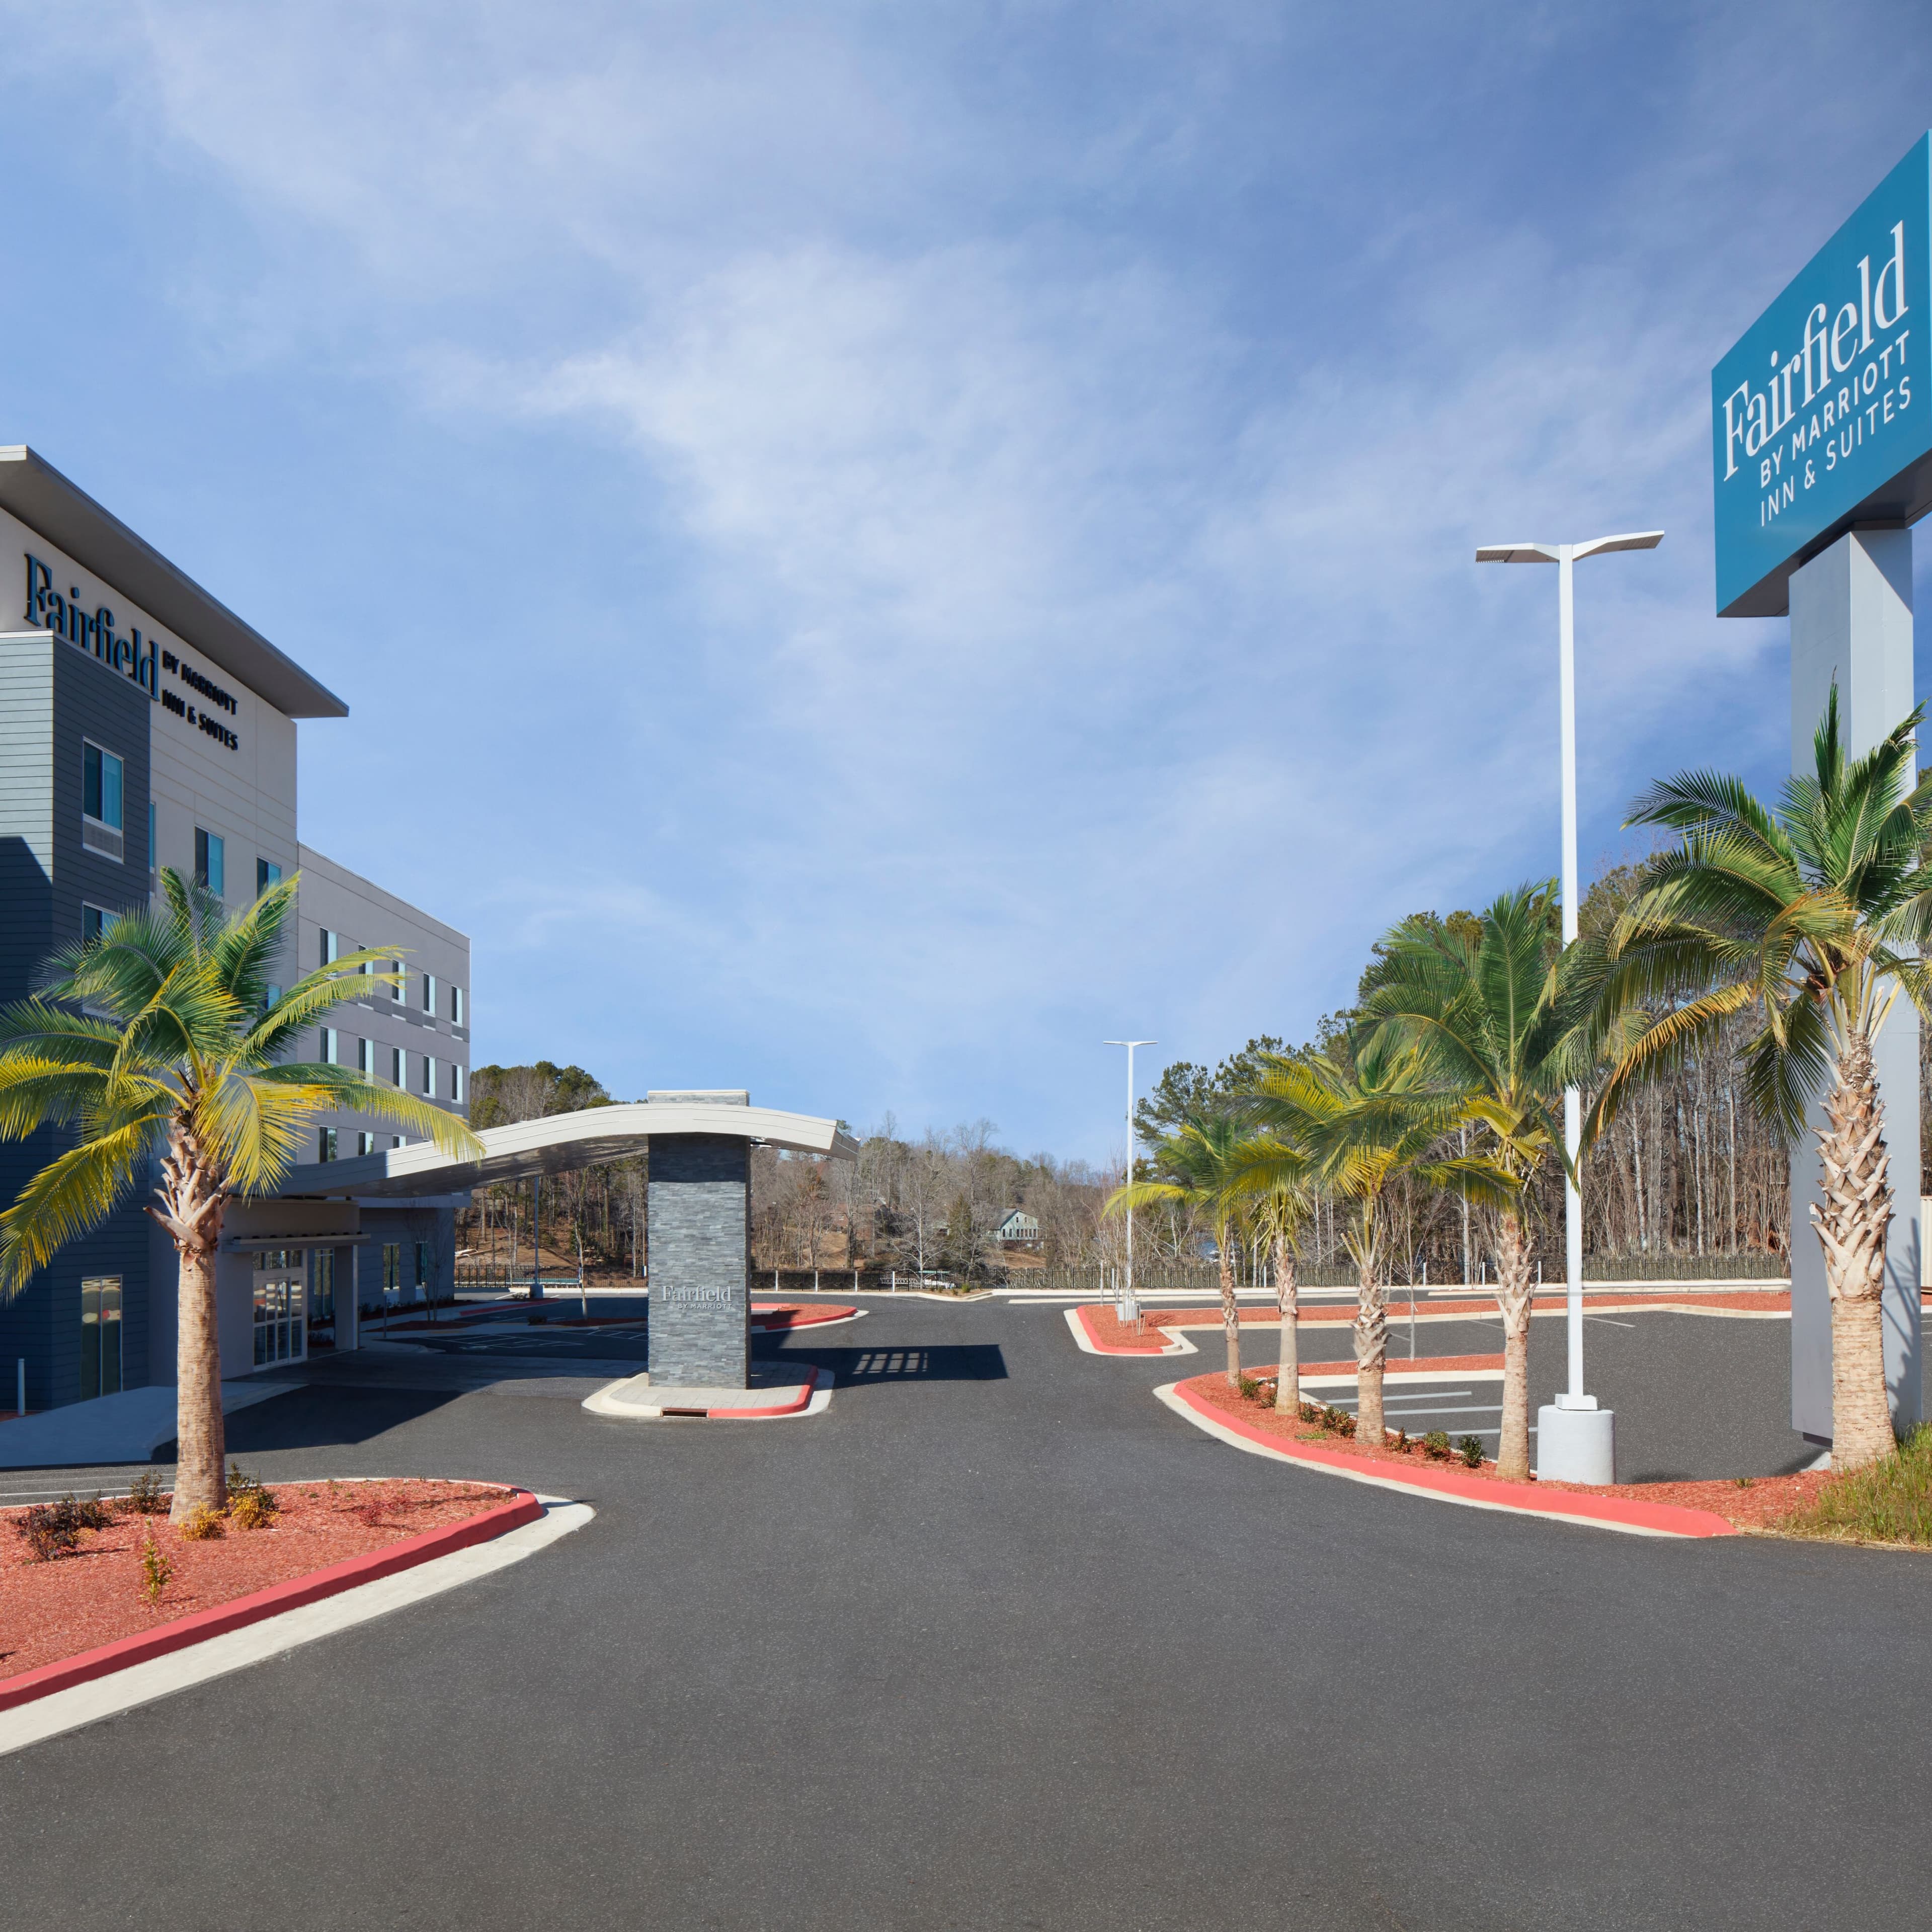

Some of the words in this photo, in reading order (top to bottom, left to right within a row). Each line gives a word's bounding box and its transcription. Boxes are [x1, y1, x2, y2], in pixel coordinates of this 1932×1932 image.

[1723, 220, 1908, 482] Fairfield
[1760, 445, 1783, 488] BY
[1792, 330, 1910, 461] MARRIOTT
[1761, 475, 1795, 526] INN
[1804, 459, 1815, 490] &
[1826, 375, 1910, 471] SUITES
[24, 553, 160, 701] Fairfield
[163, 651, 180, 674] BY
[182, 664, 238, 715] MARRIOTT
[162, 689, 185, 717] INN
[188, 706, 197, 725] &
[199, 713, 239, 750] SUITES
[662, 1285, 733, 1303] Fairfield
